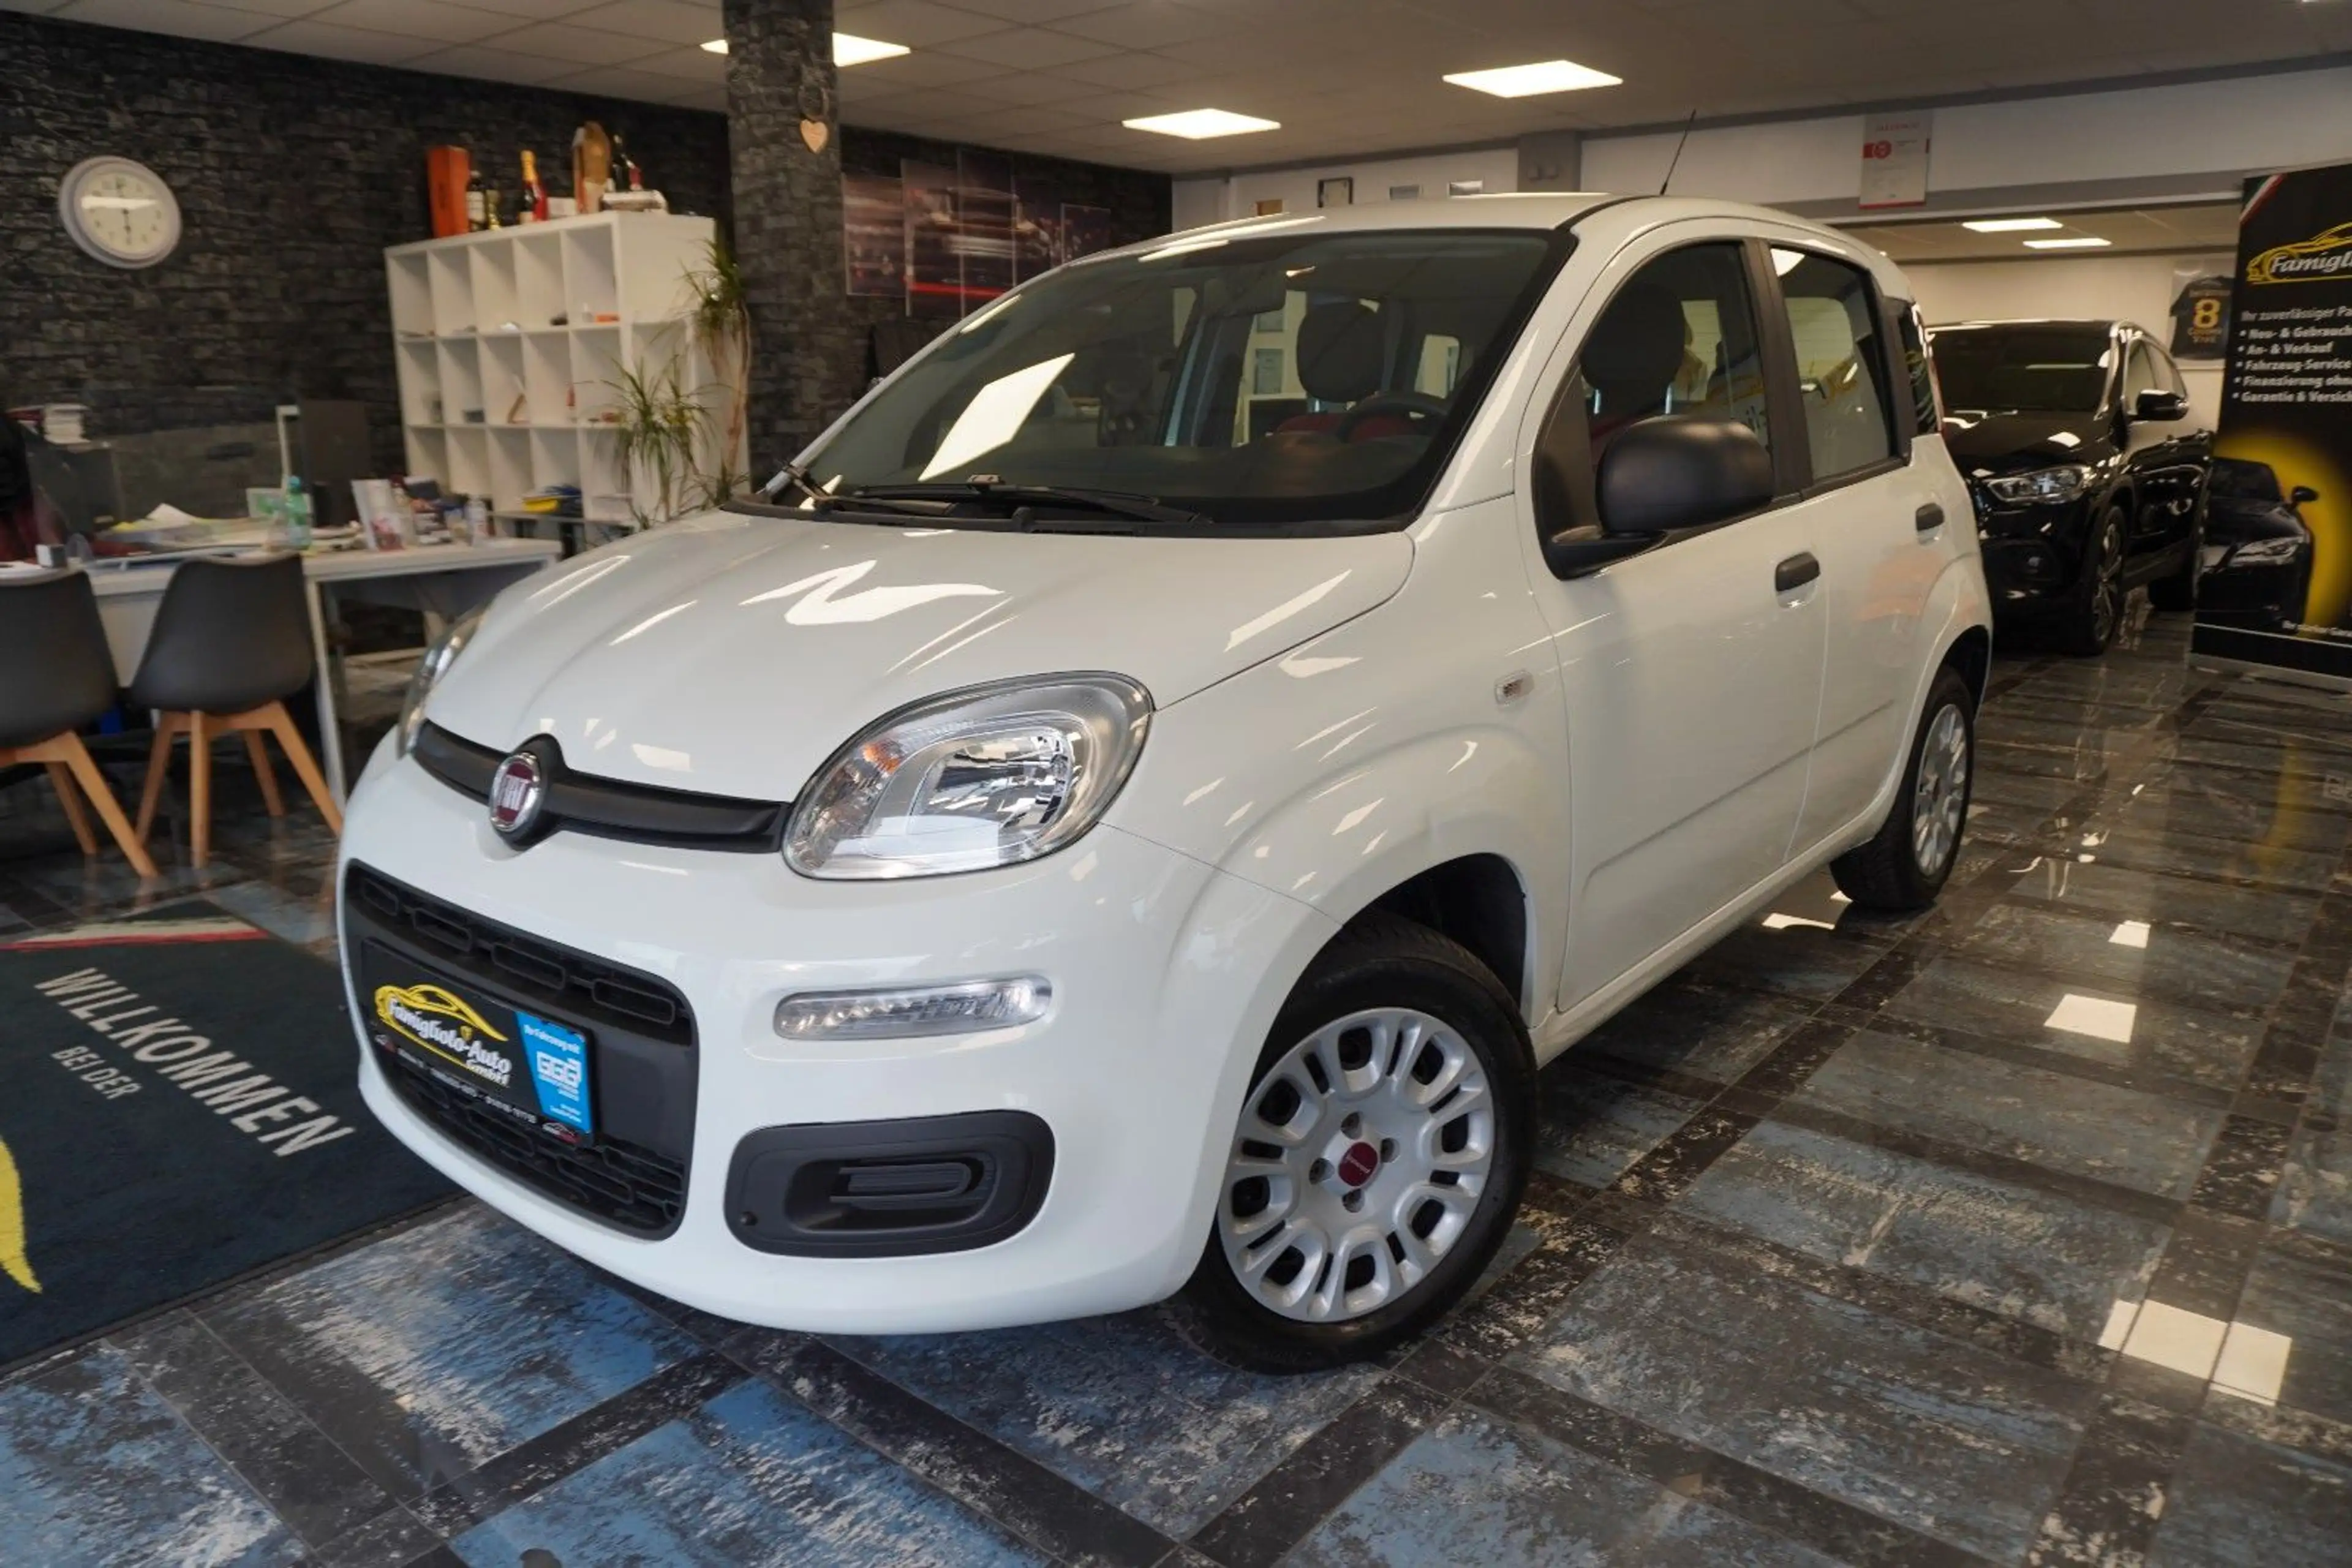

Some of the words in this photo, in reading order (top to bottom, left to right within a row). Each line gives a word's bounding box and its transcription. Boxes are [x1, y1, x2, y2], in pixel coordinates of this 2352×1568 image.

[2193, 298, 2222, 330] 8
[2279, 327, 2291, 338] &
[2270, 343, 2282, 355] &
[2283, 341, 2334, 355] Verkauf
[2242, 375, 2324, 388] Finanzierung
[2241, 391, 2294, 402] Garantie
[34, 967, 356, 1158] WILLKOMMEN
[51, 1046, 109, 1072] BEI
[80, 1066, 143, 1101] DER
